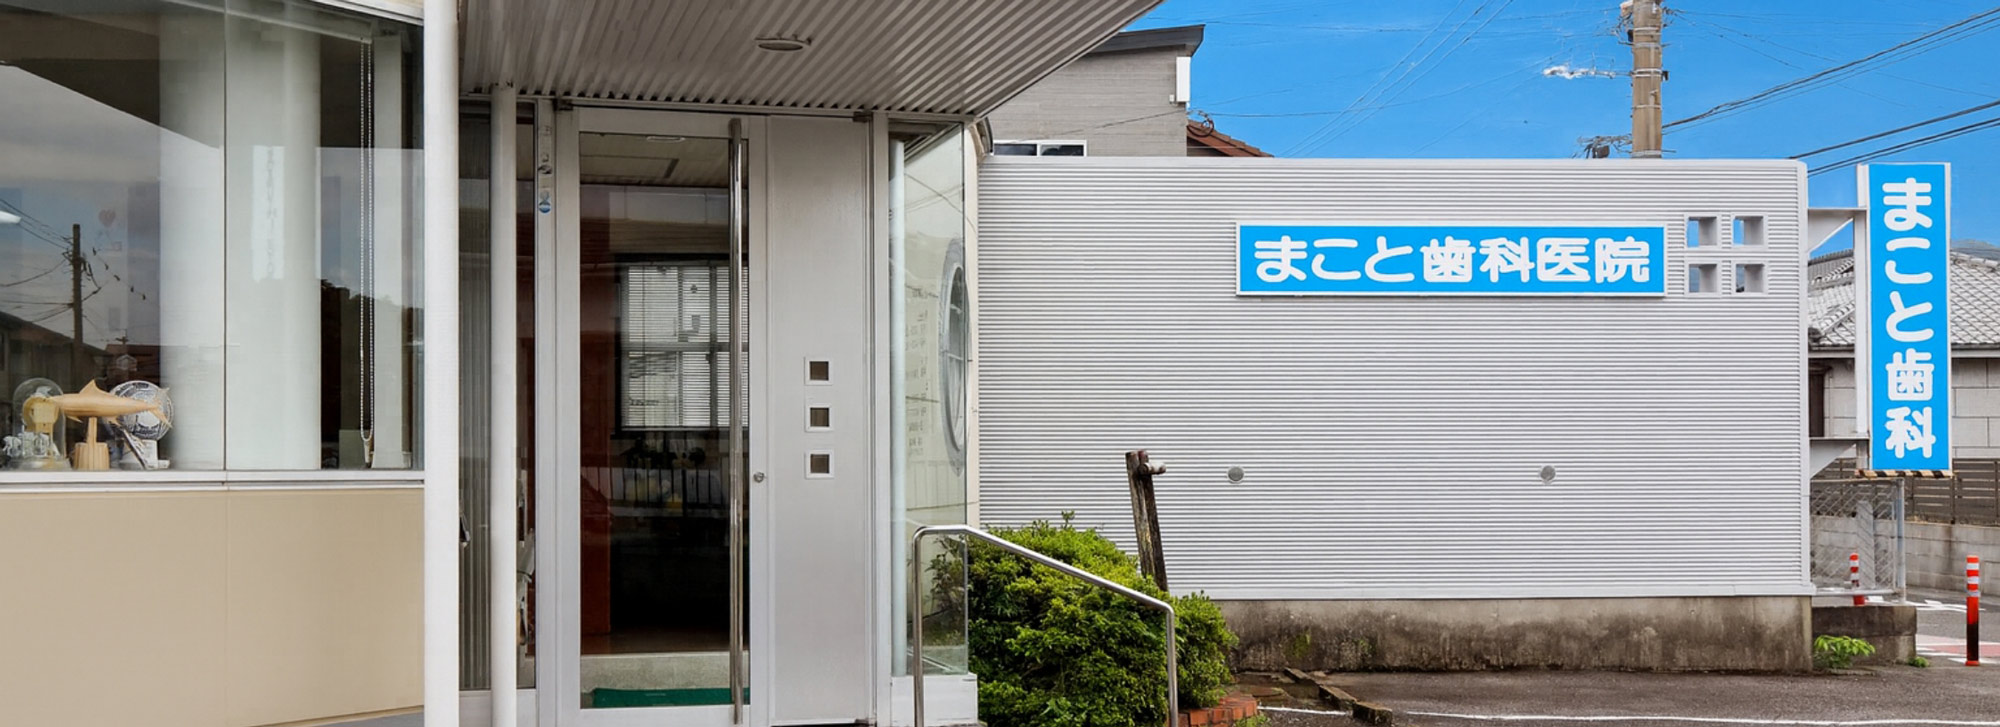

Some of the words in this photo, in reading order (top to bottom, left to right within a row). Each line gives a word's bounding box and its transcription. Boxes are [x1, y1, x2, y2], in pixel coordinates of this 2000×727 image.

[1254, 235, 1650, 284] まこと歯科医院
[1882, 177, 1936, 459] まこと歯科
